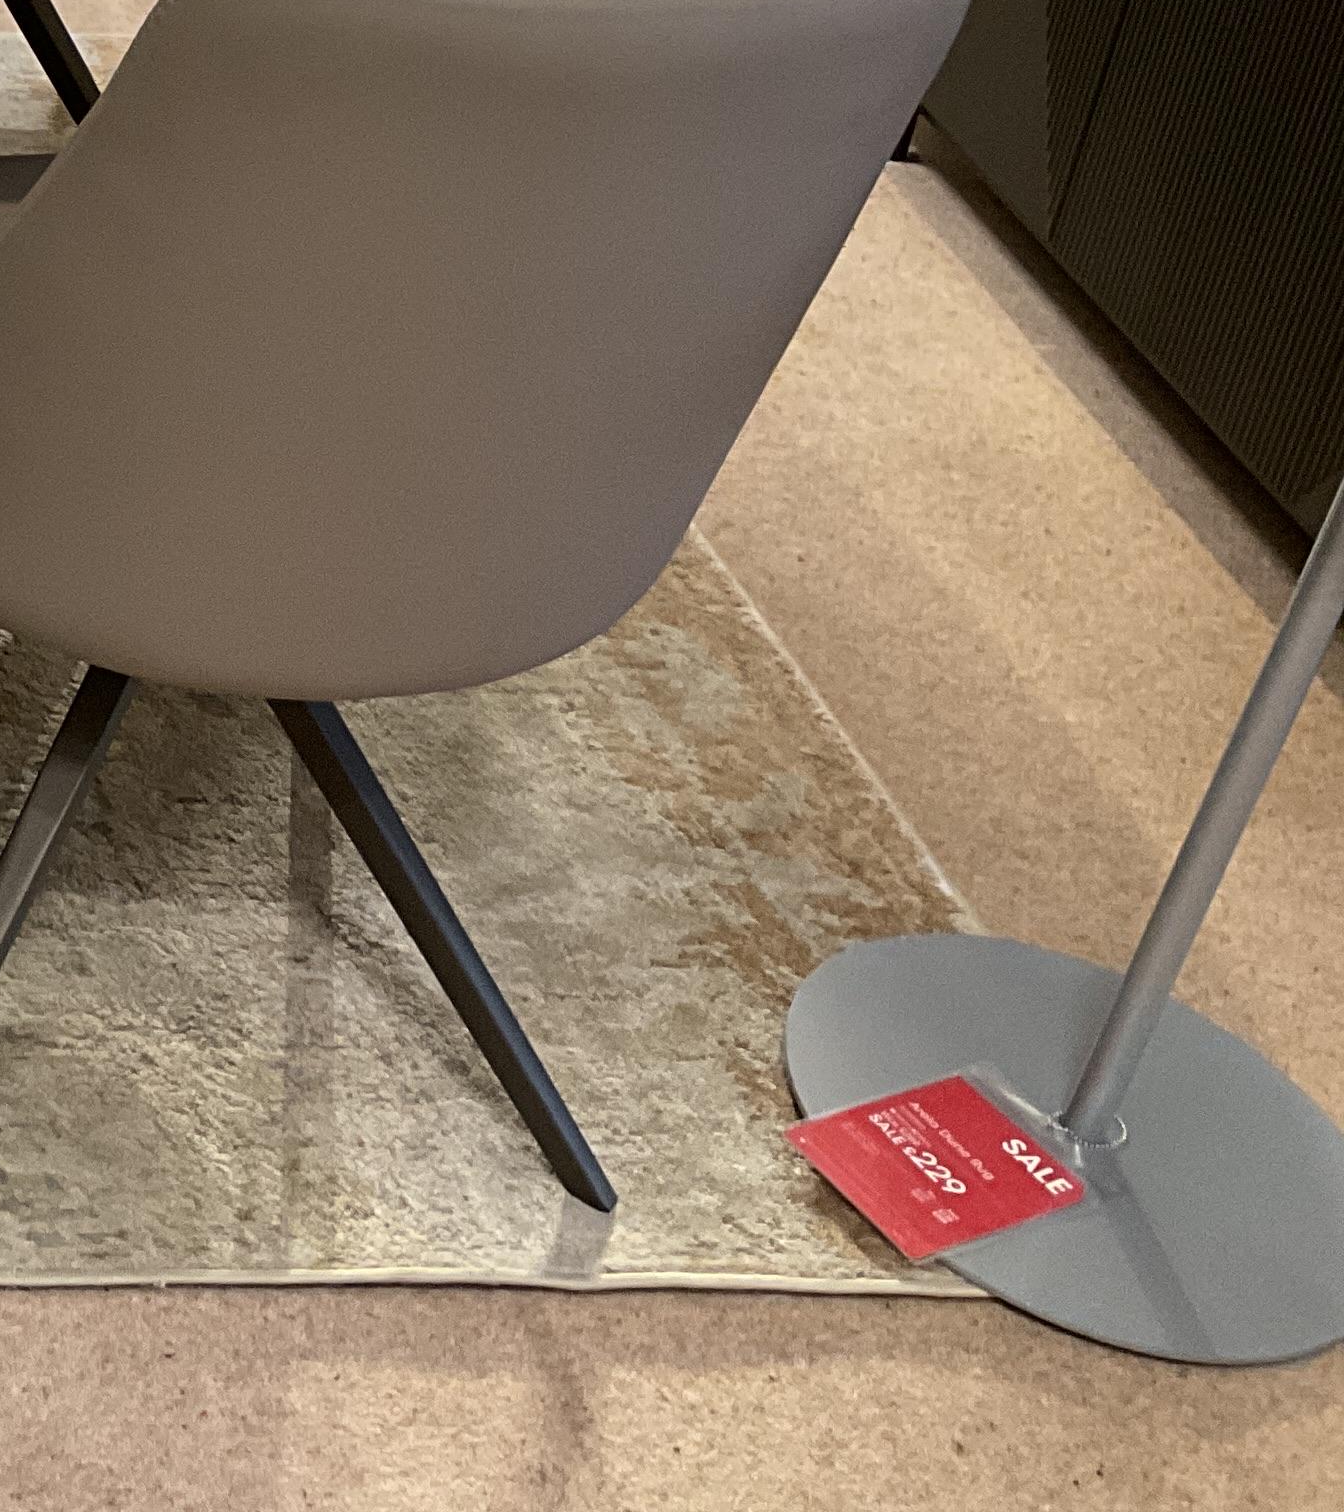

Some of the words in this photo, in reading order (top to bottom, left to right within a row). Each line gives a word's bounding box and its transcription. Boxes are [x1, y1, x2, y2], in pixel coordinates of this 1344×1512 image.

[868, 1113, 906, 1146] SALE
[902, 1146, 967, 1194] £229
[1001, 1137, 1074, 1196] SALE
